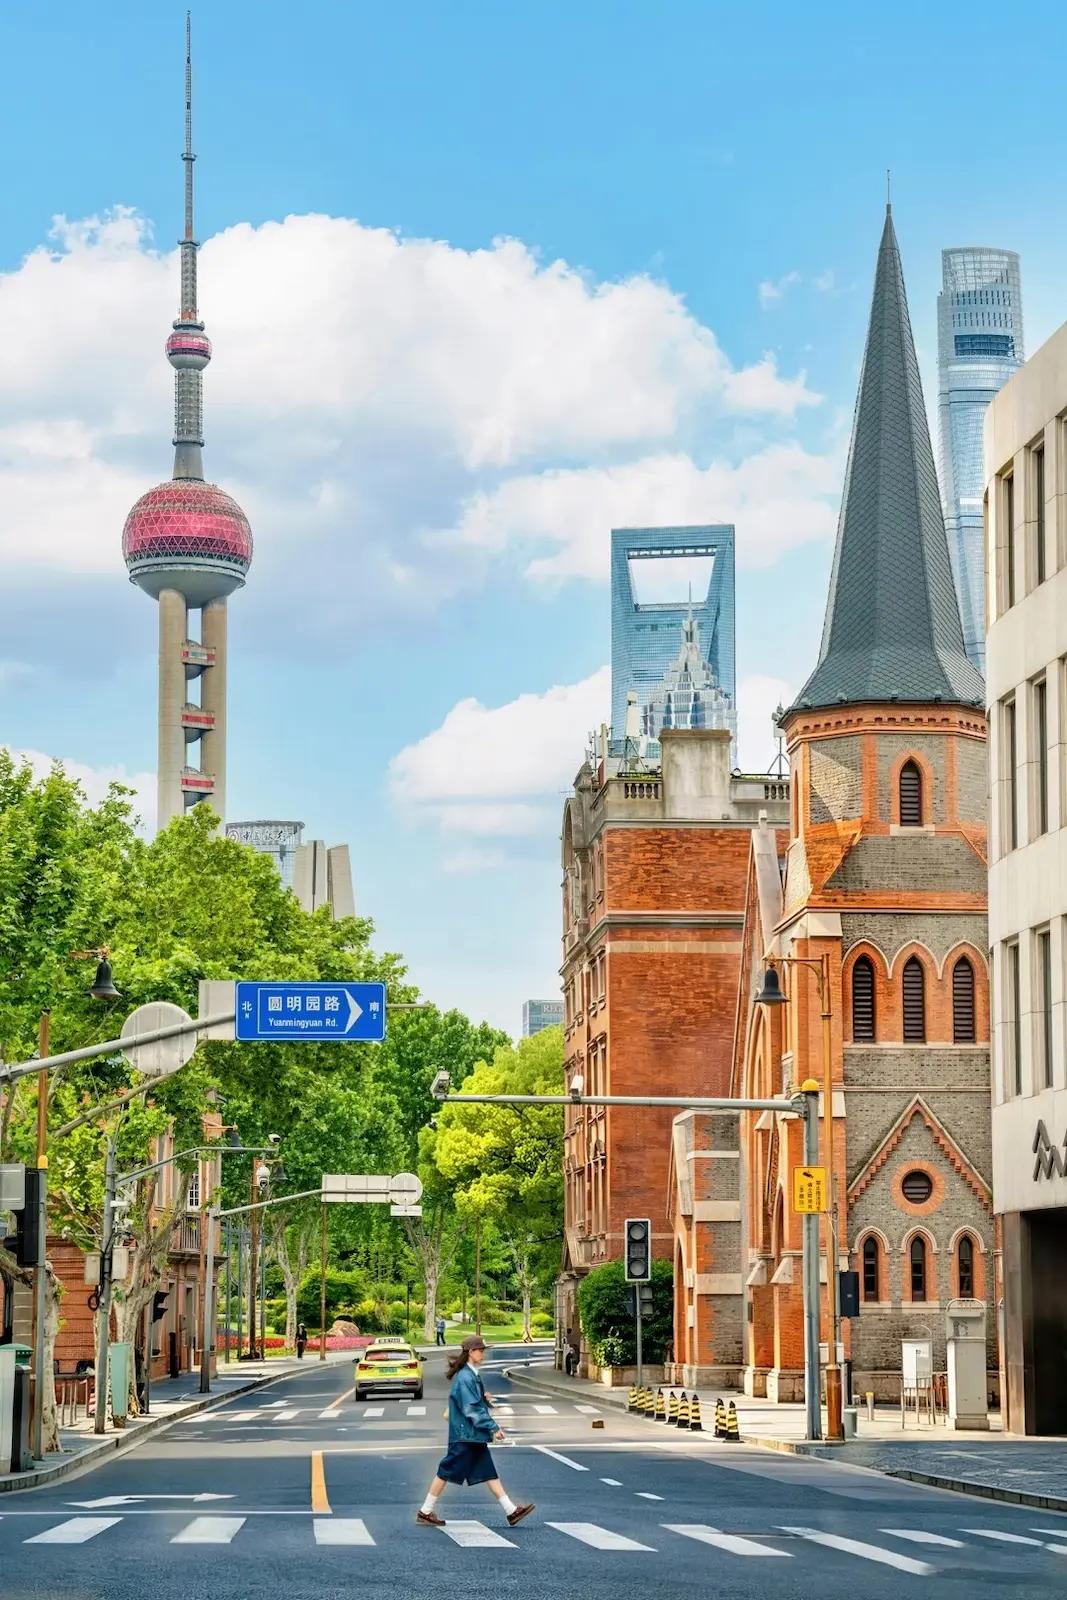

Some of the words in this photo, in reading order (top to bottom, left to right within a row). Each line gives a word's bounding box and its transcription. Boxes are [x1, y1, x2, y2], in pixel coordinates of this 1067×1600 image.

[242, 1001, 252, 1011] 北
[268, 996, 340, 1011] 圆明园路
[369, 1002, 379, 1012] 南
[268, 1018, 323, 1029] Yuanmingyuan
[325, 1018, 338, 1027] Rd.
